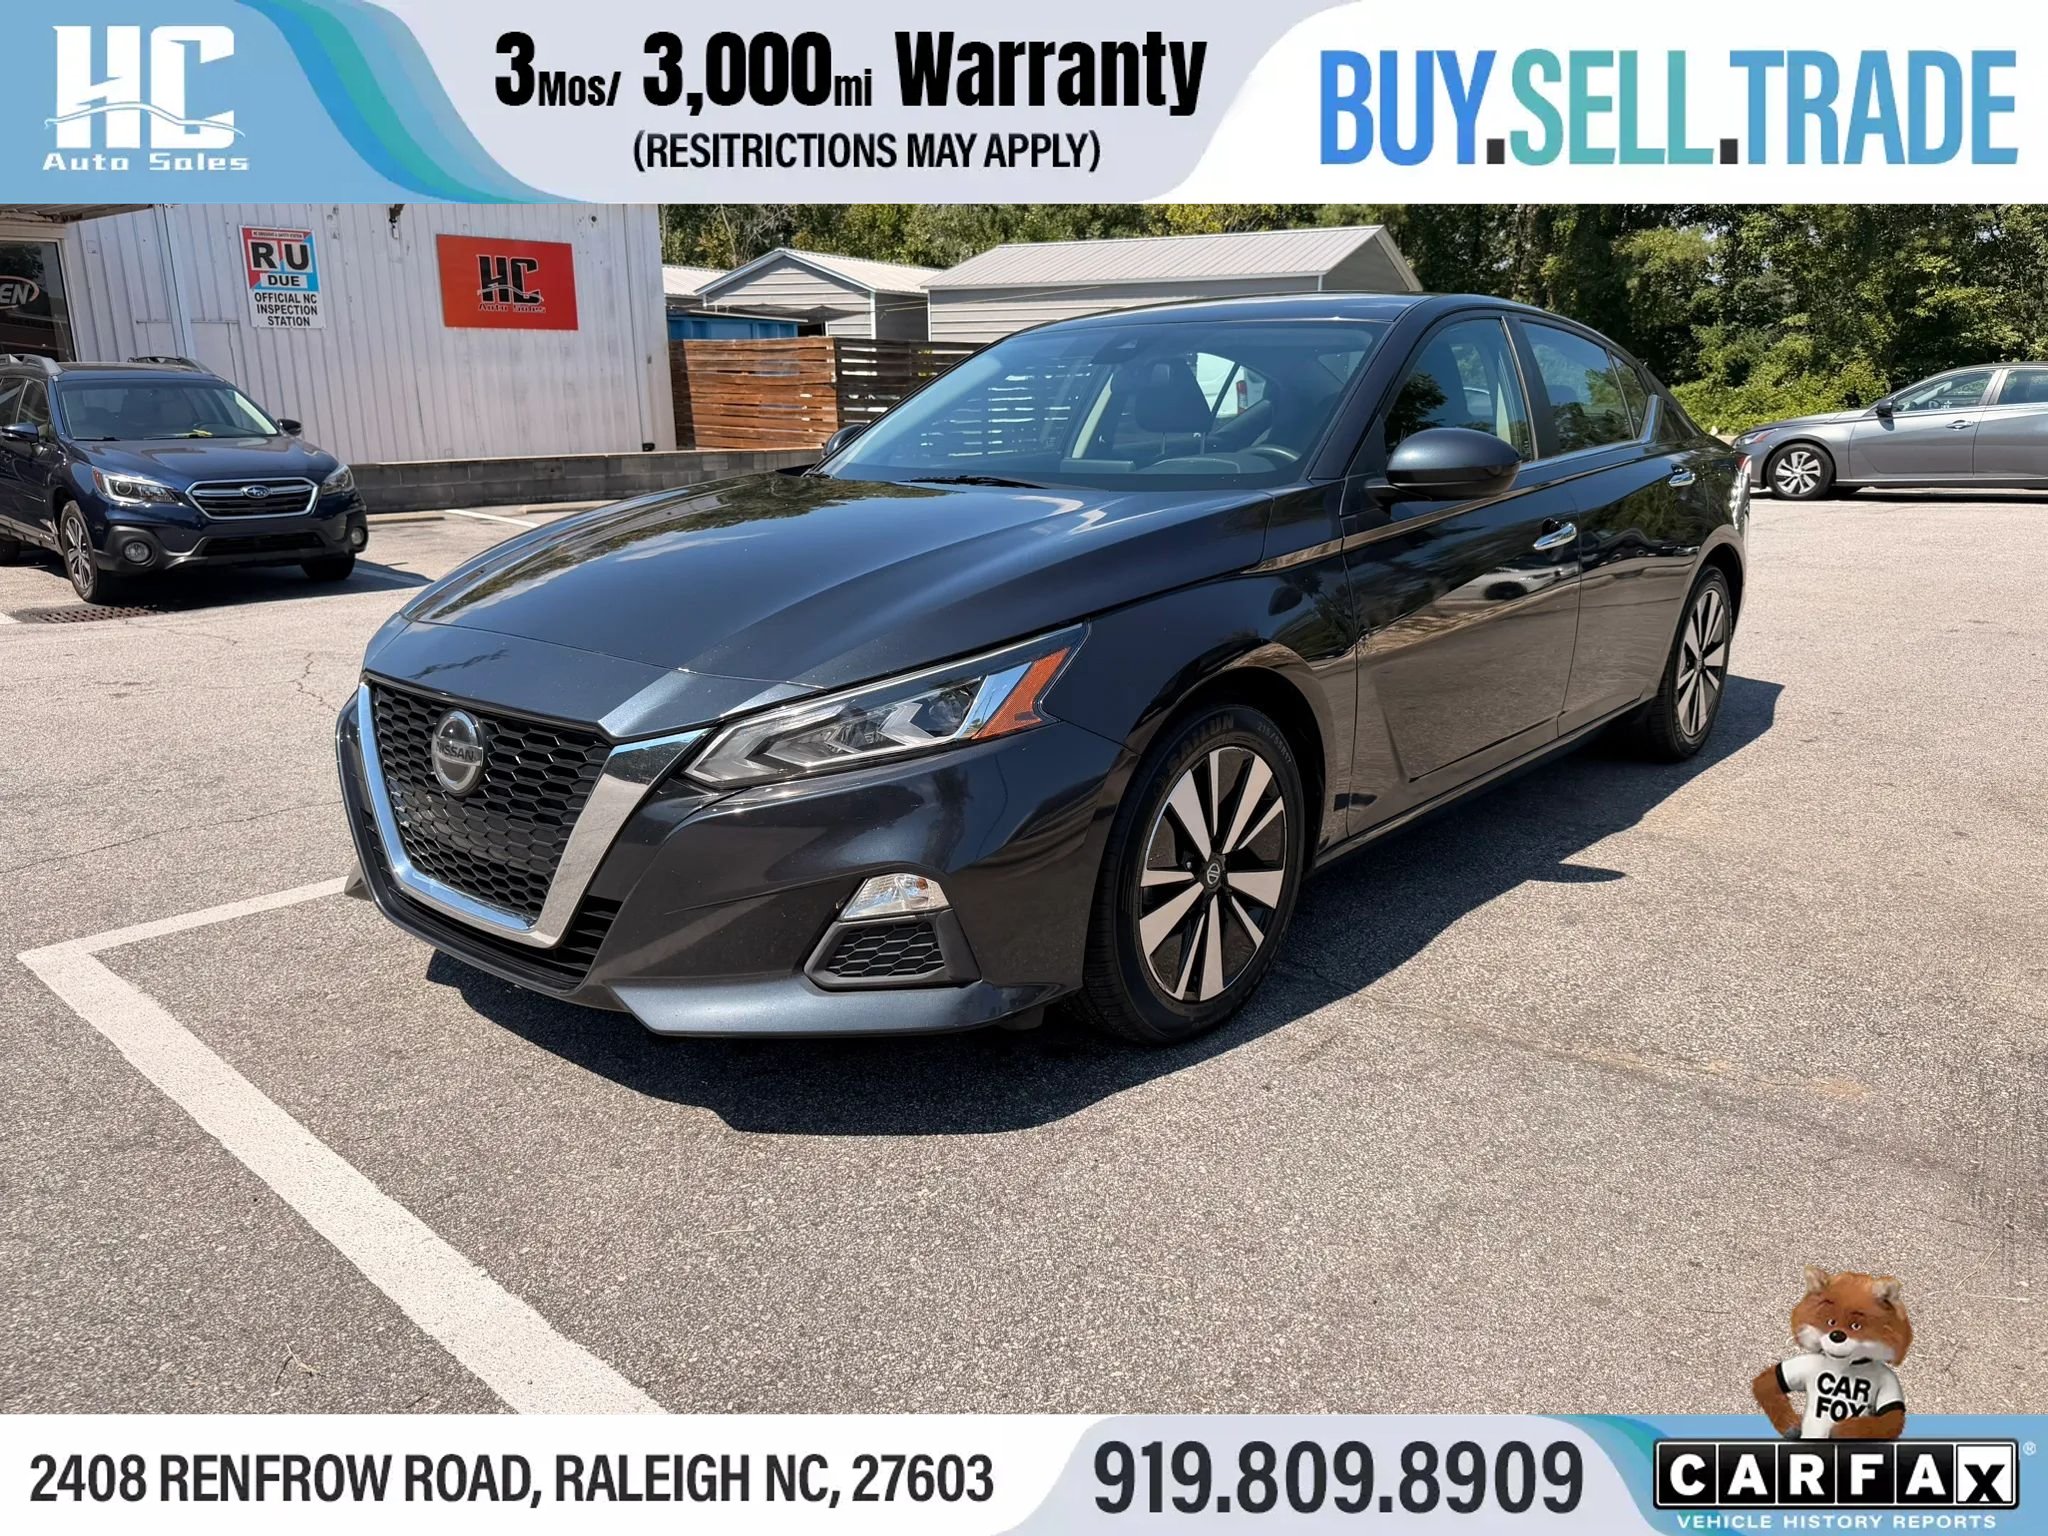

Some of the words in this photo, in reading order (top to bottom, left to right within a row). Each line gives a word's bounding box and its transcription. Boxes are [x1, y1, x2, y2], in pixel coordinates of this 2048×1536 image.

[267, 274, 301, 287] DUE
[476, 254, 539, 305] HC
[254, 292, 301, 304] OFFICIAL
[303, 293, 318, 304] NC
[256, 304, 318, 316] INSPECTION
[267, 315, 311, 327] STATION
[436, 740, 475, 761] NISSAN
